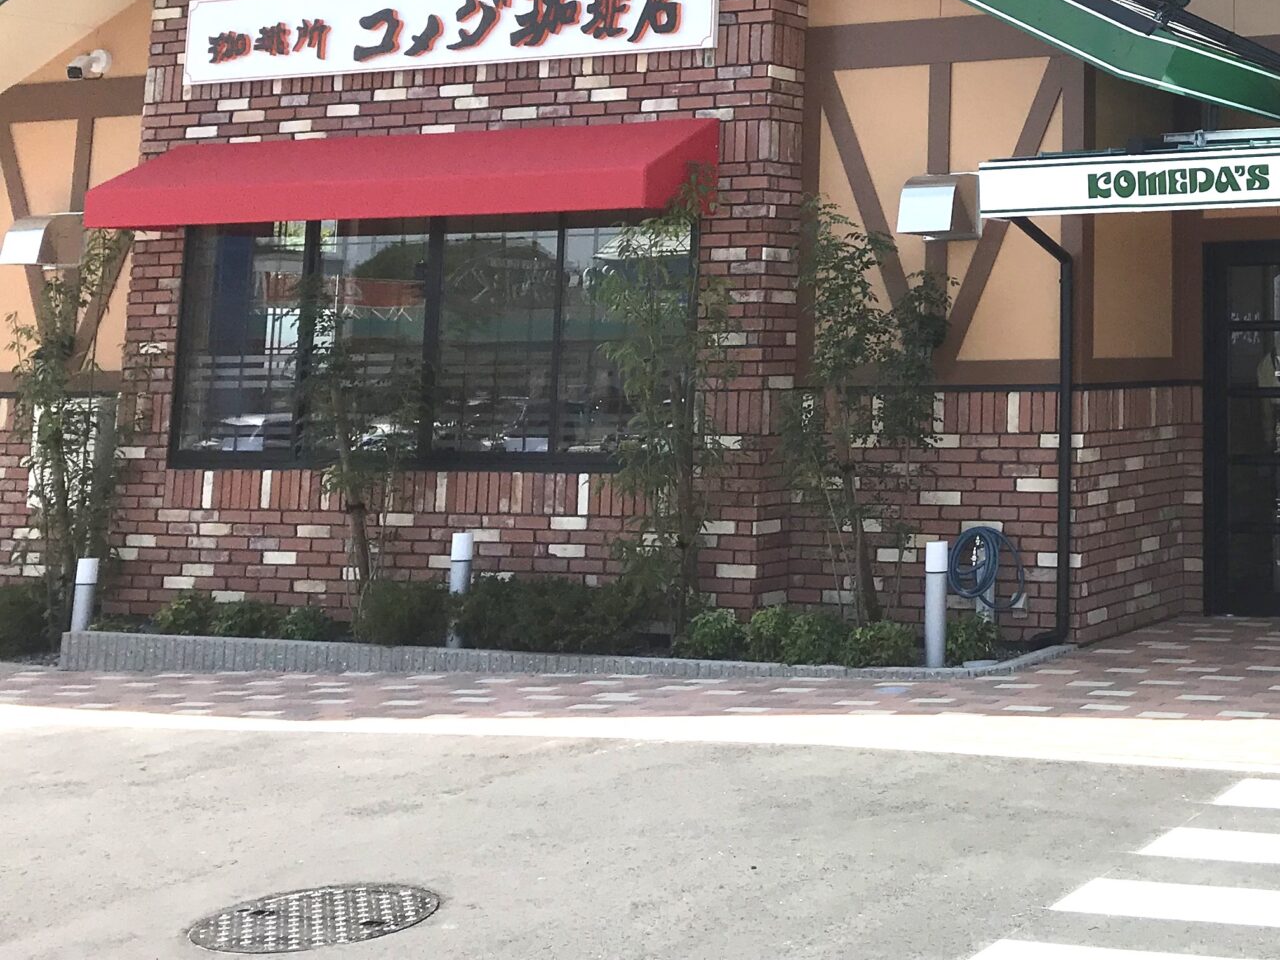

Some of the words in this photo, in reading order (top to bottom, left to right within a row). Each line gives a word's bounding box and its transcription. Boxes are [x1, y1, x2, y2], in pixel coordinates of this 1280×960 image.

[208, 18, 331, 64] 珈琲所
[1087, 164, 1269, 199] KOMEDA'S
